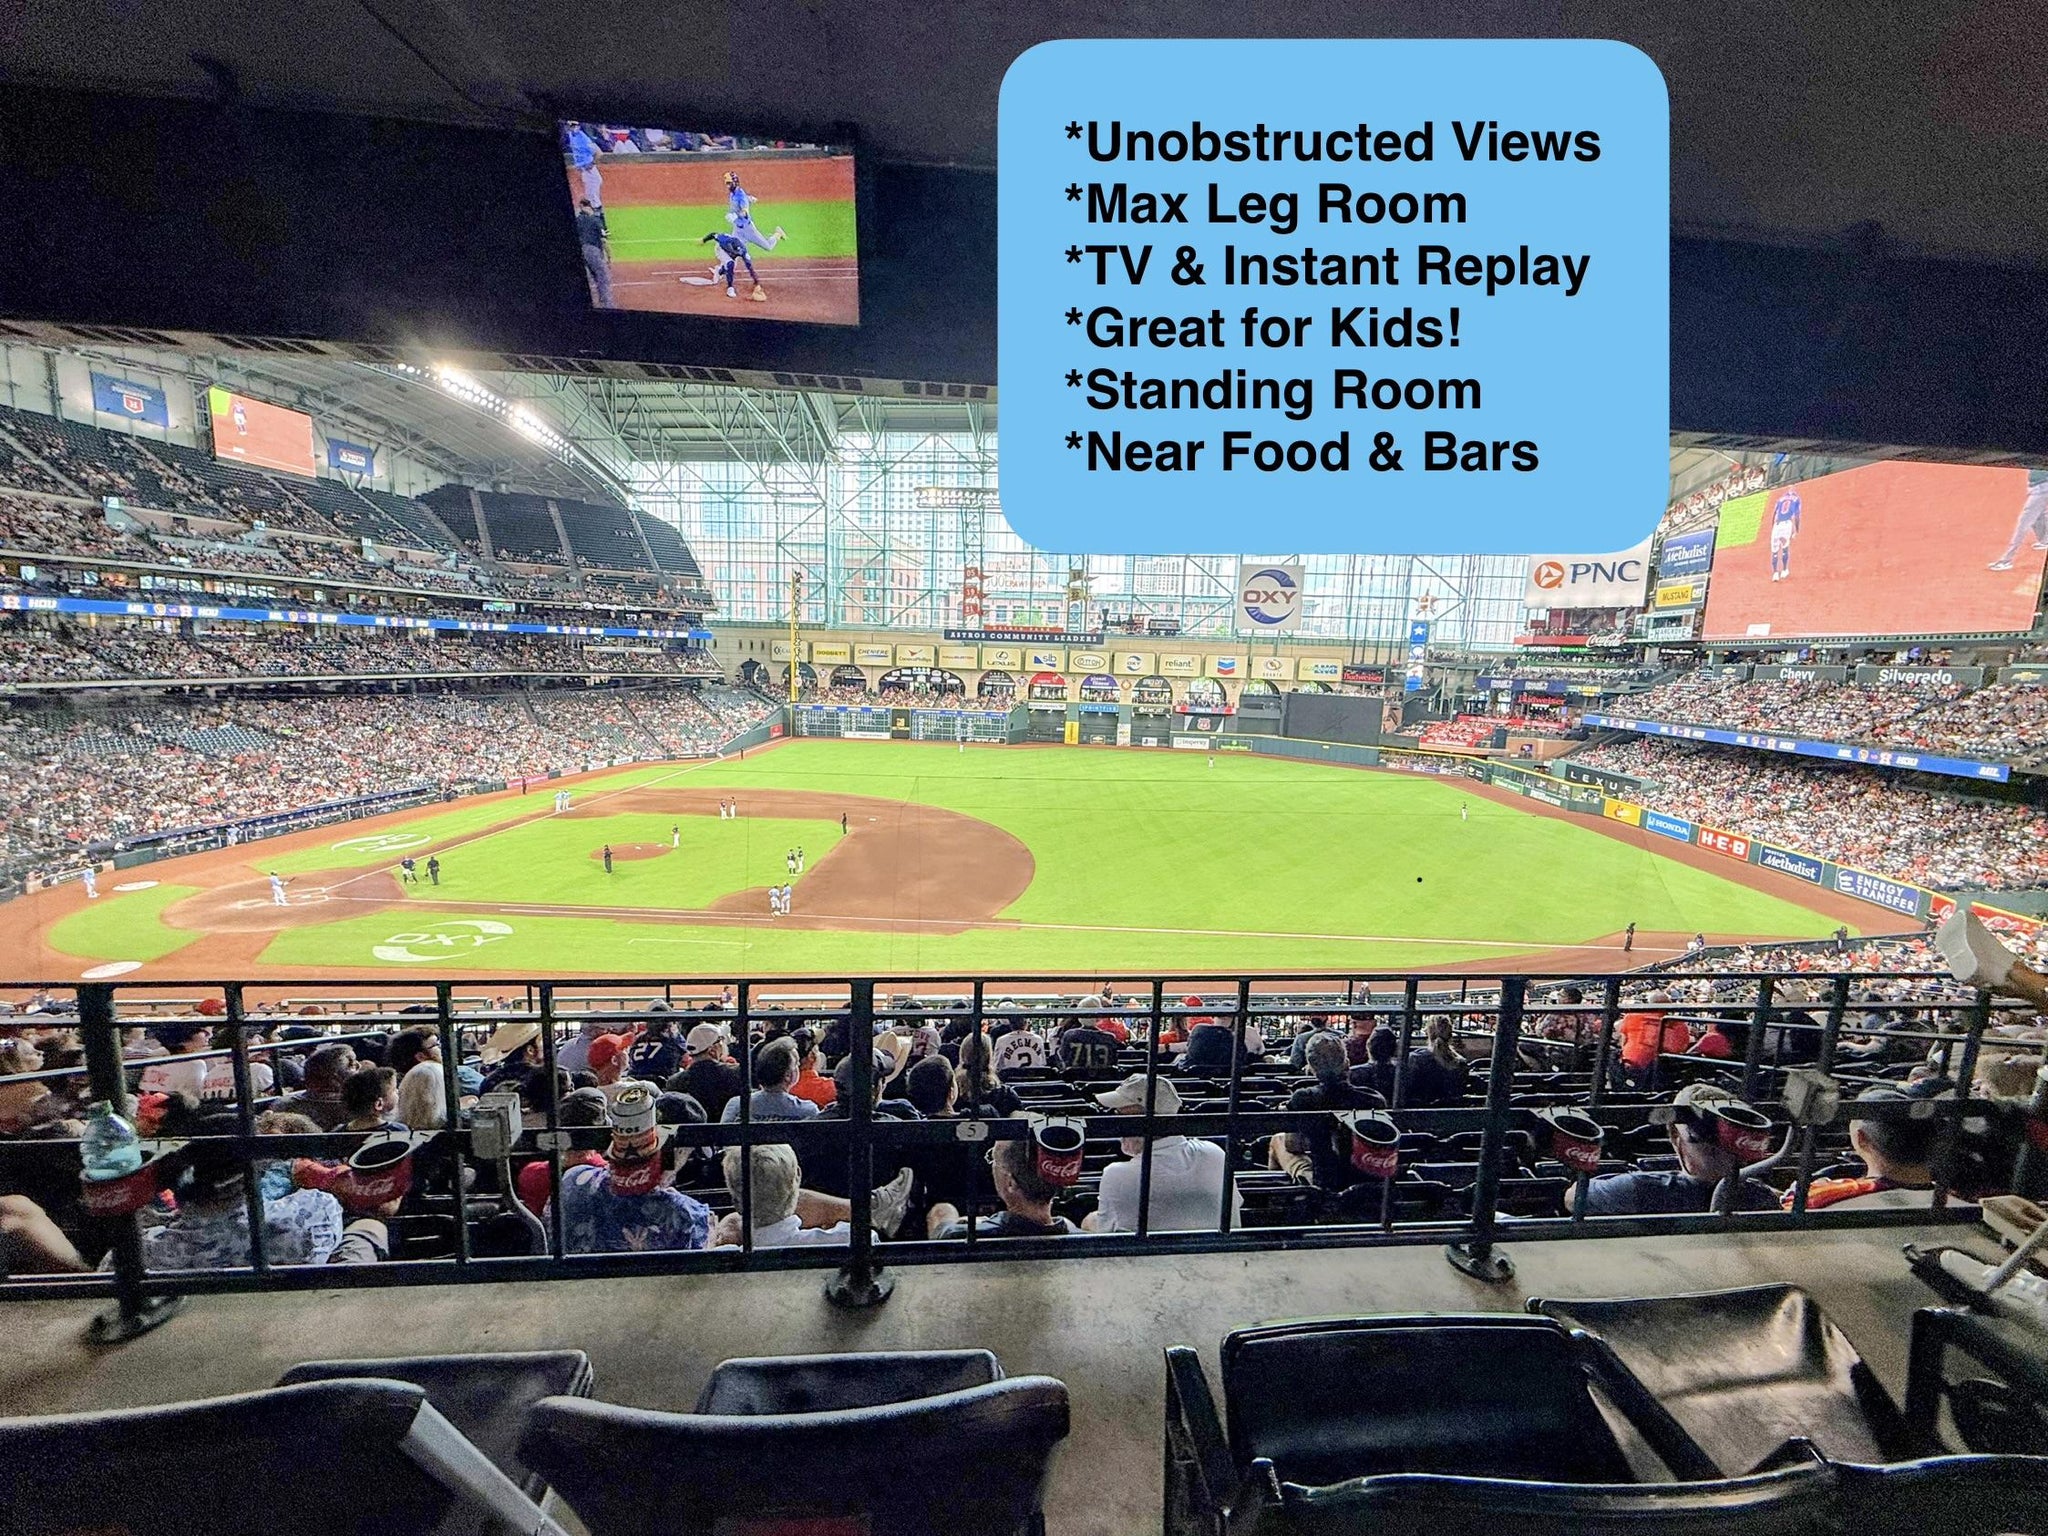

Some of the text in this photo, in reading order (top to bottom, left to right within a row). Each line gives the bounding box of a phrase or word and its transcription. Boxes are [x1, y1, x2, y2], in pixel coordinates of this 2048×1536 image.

[1664, 544, 1708, 563] Methodist
[1570, 560, 1641, 583] PNC
[1243, 590, 1297, 603] OXY
[1662, 590, 1689, 600] MUSTANG
[990, 633, 1050, 641] COMMUNITY
[857, 648, 888, 656] CHENIERE
[1043, 653, 1057, 663] slb
[1343, 672, 1384, 682] Budweiser
[1780, 668, 1953, 685] Chevy Silverado
[1570, 771, 1633, 792] LEXUS
[1656, 820, 1689, 836] HONDA
[1763, 854, 1819, 880] Methodist
[1856, 875, 1905, 897] ENERGY
[1854, 885, 1915, 912] TRANSFER
[385, 933, 507, 947] OXY
[633, 1042, 663, 1061] 27
[1018, 1052, 1032, 1067] 2
[1070, 1042, 1109, 1067] 713
[966, 1125, 977, 1138] 5
